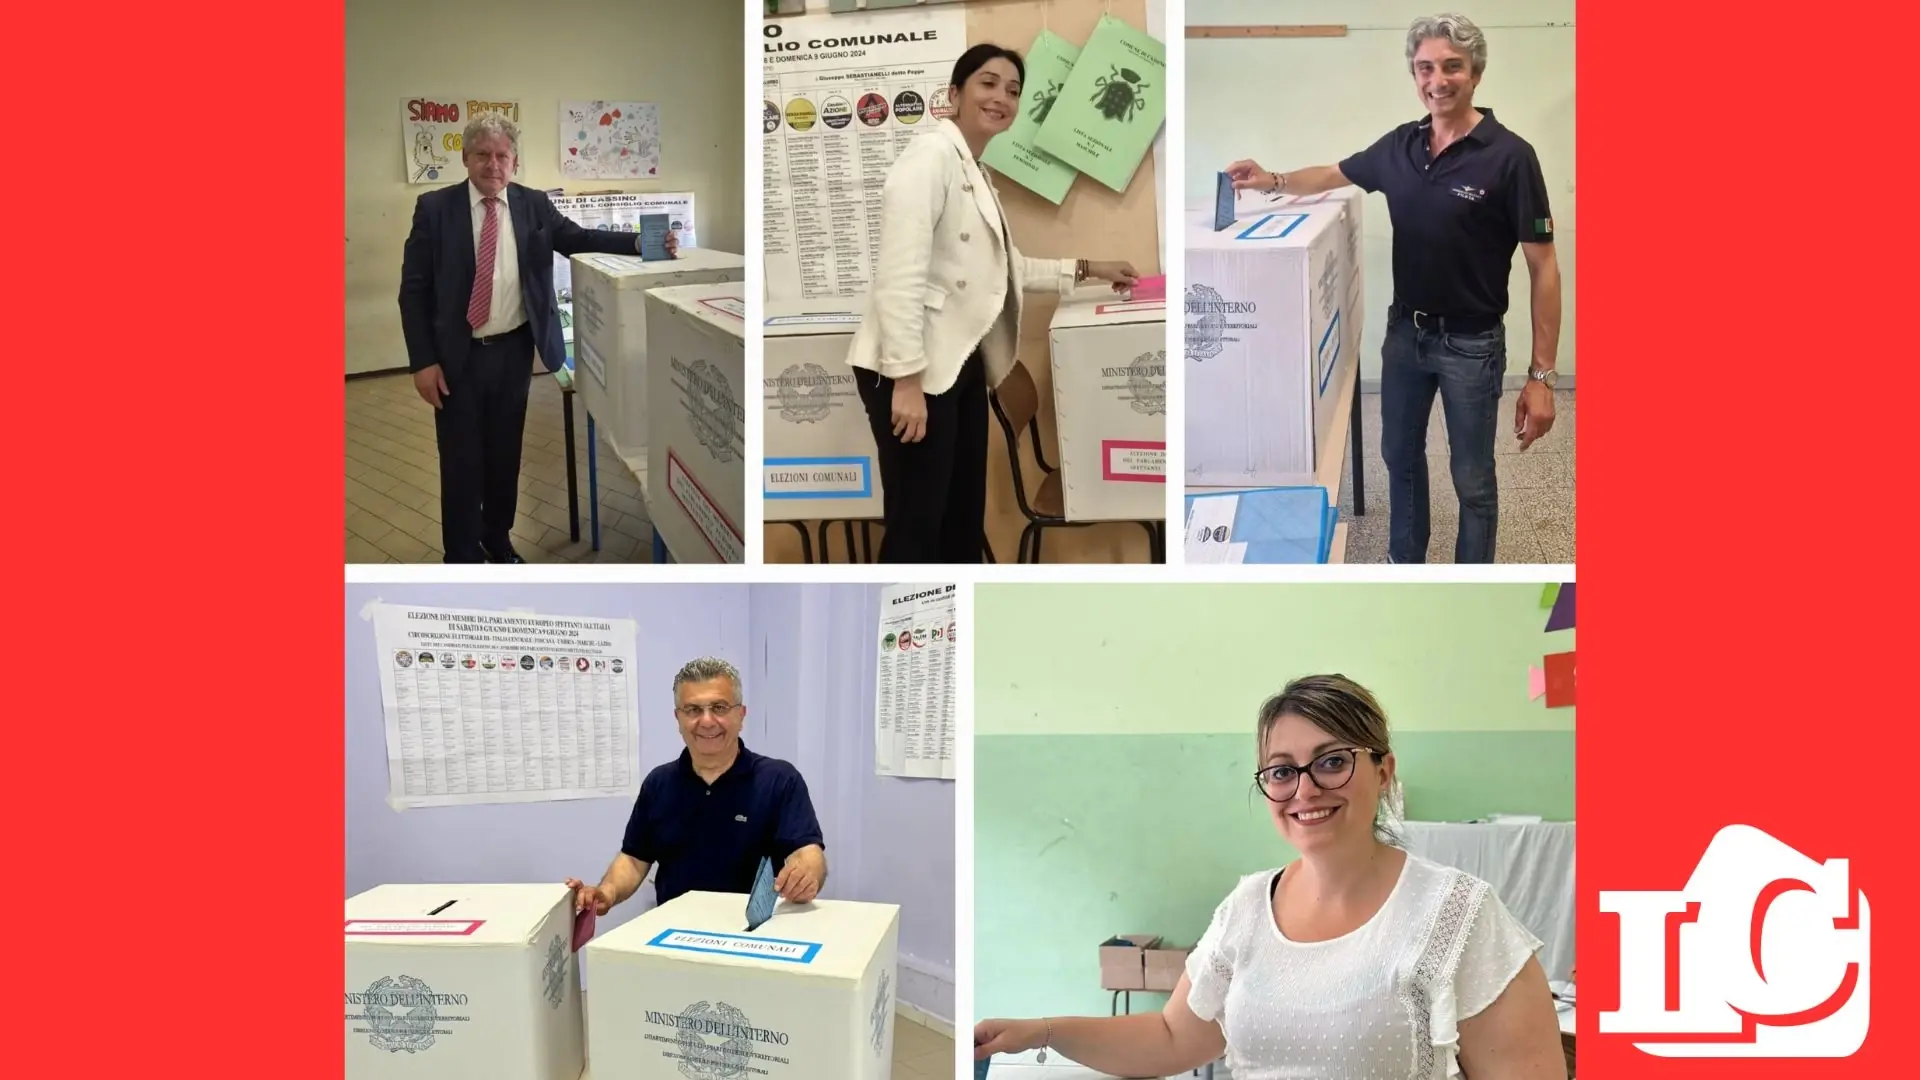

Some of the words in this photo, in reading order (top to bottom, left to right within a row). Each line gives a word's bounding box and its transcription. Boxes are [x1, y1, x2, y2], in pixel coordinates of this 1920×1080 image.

[808, 30, 938, 50] COMUNALE
[776, 54, 812, 62] DOMENICA
[820, 51, 848, 60] GIUGNO
[850, 50, 866, 58] 2024
[846, 71, 890, 80] SEBASTIANELLI
[1184, 302, 1256, 314] DELL'INTERNO
[1101, 366, 1148, 378] MINISTERO
[770, 472, 808, 483] ELEZIONI
[812, 472, 857, 482] COMUNALI
[892, 588, 942, 605] ELEZIONE
[408, 612, 439, 620] ELEZIONE
[490, 617, 527, 625] PARLAMENTO
[456, 624, 479, 632] SABATO
[674, 935, 728, 947] ELEZIONI
[733, 941, 797, 953] COMUNALI
[391, 993, 468, 1006] DELL'INTERNO
[644, 1010, 703, 1030] MINISTERO
[705, 1020, 789, 1046] DELL'INTERNO
